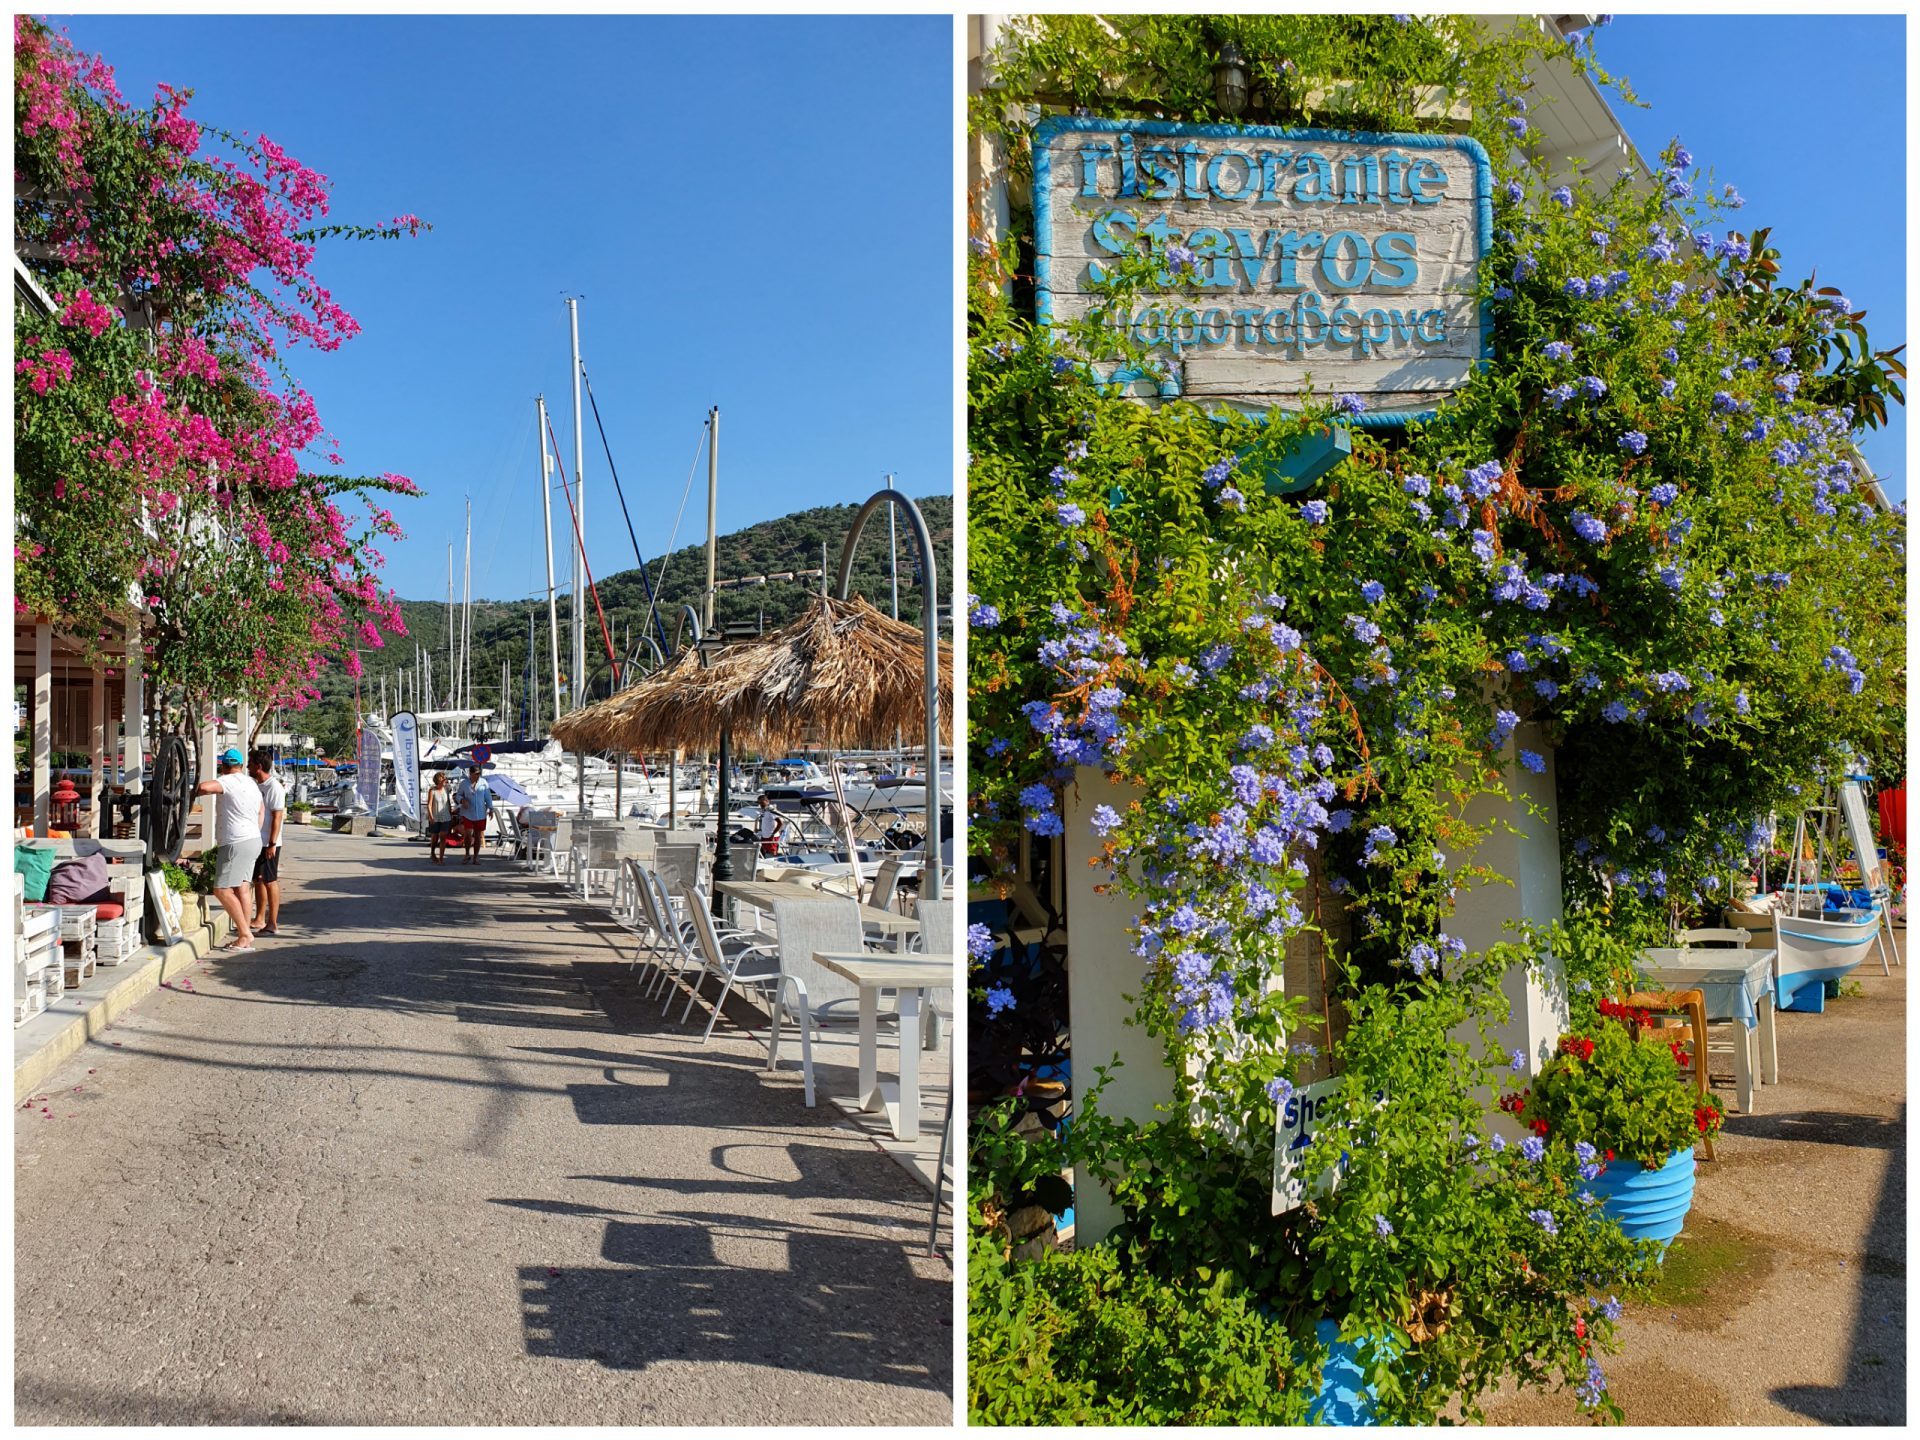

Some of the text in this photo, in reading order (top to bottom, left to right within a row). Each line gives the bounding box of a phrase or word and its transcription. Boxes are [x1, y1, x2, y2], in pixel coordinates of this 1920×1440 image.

[1079, 132, 1450, 205] ristorante
[1088, 209, 1419, 290] Stavros
[1088, 291, 1448, 354] αροταβέρνα
